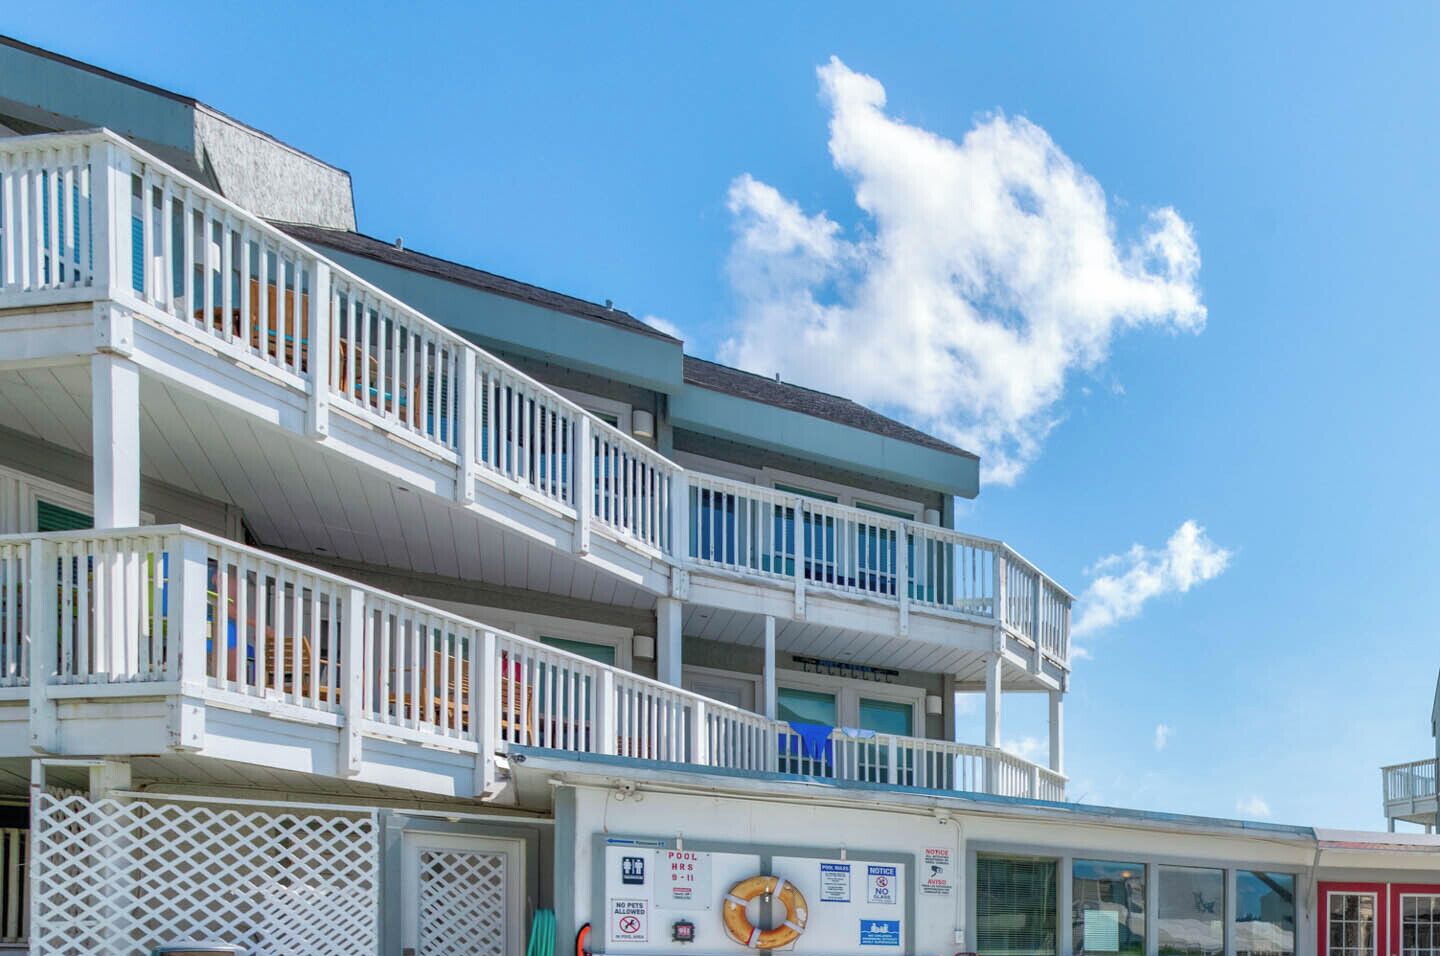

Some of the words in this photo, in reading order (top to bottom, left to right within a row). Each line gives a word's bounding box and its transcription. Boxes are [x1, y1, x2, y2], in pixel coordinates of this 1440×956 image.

[668, 852, 697, 861] POOL
[672, 863, 693, 871] HRS
[869, 867, 895, 875] NOTICE
